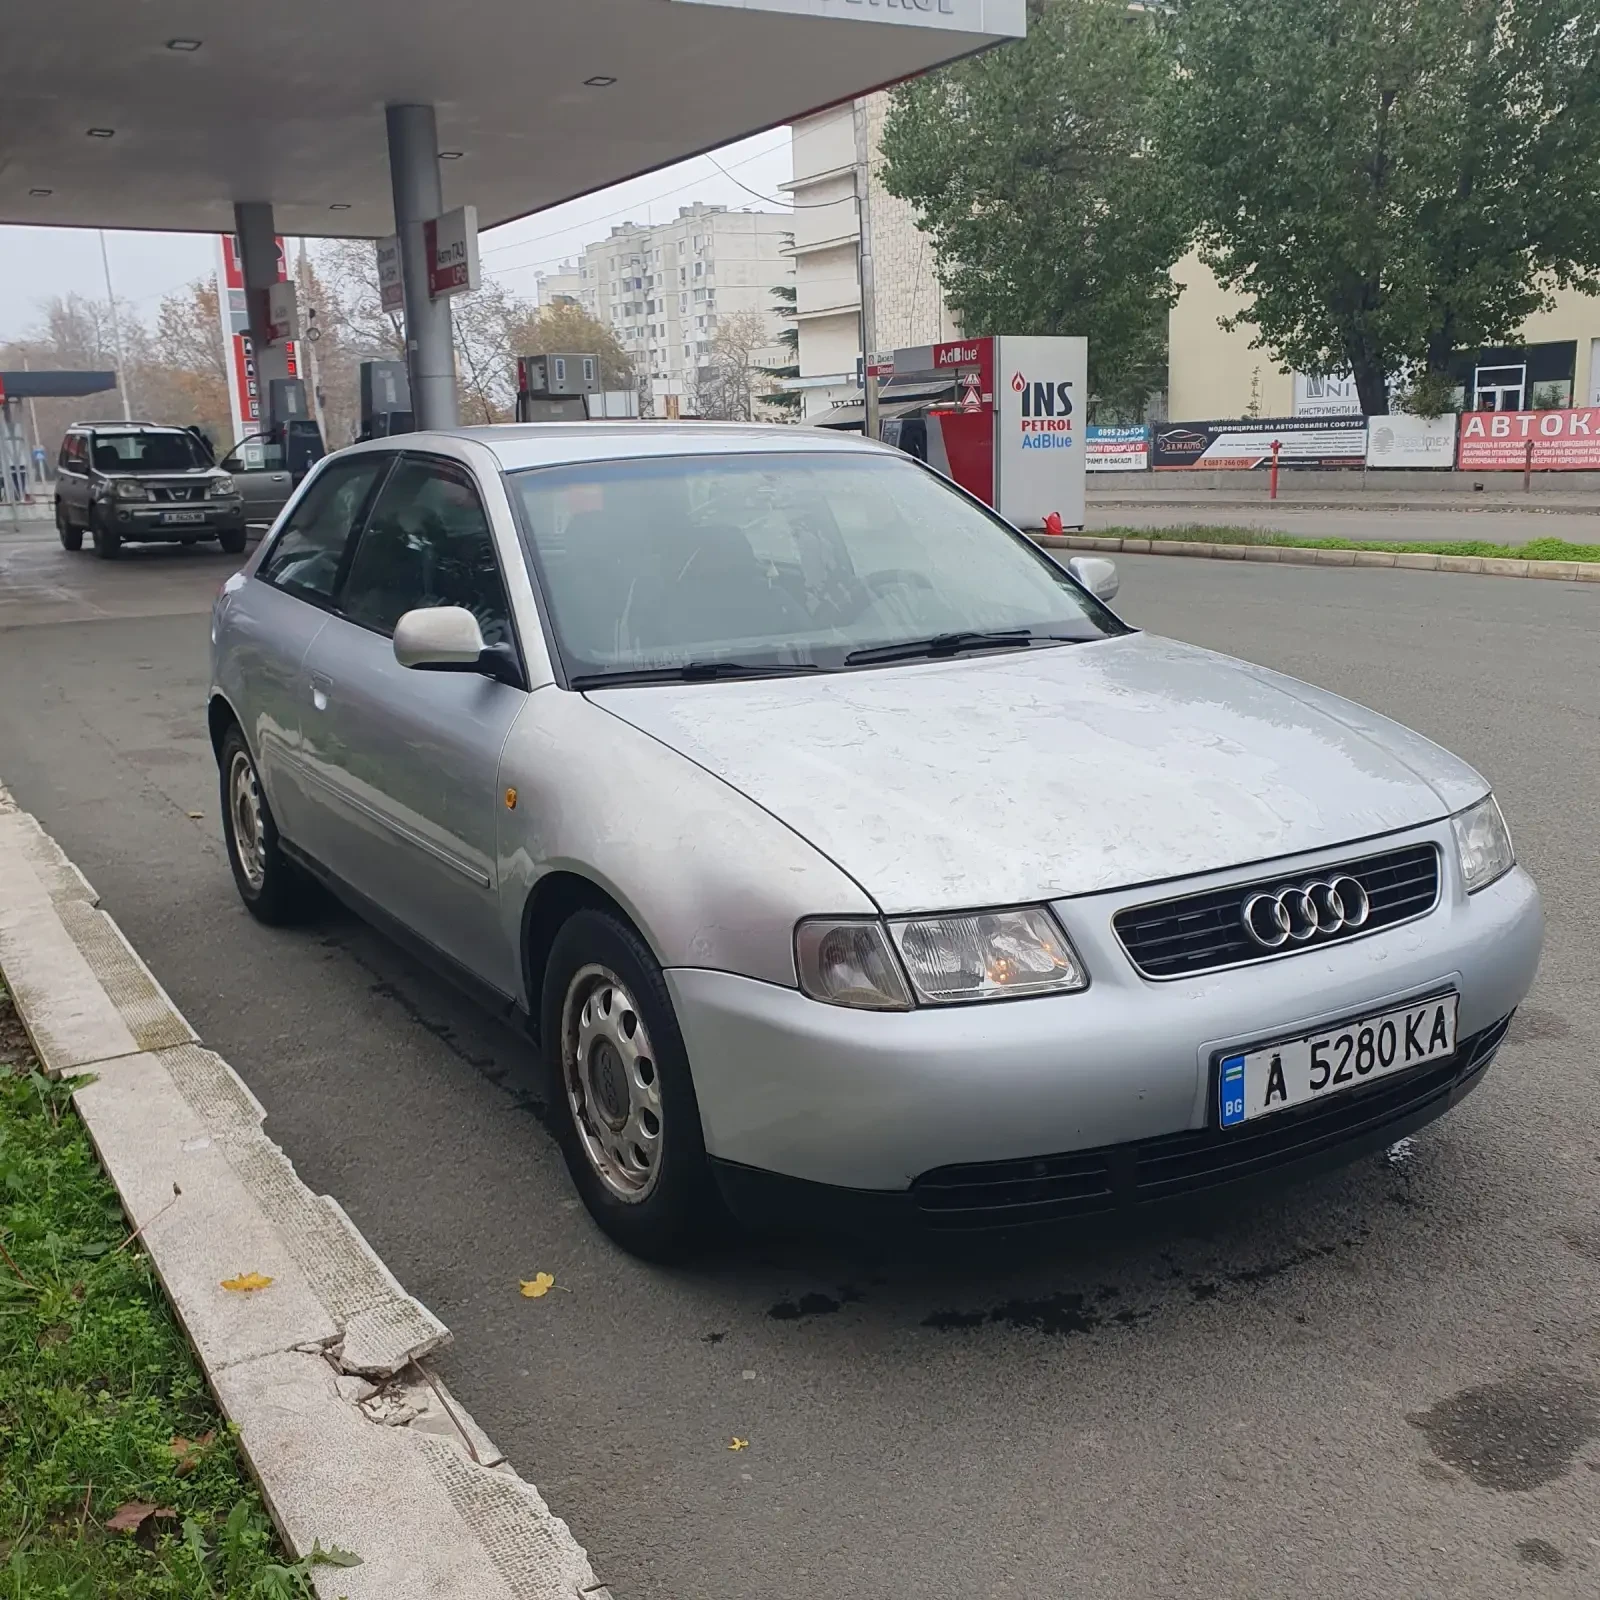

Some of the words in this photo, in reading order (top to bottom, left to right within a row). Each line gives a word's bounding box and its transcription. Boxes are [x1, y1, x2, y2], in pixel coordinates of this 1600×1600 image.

[877, 354, 893, 364] Дизел
[939, 347, 977, 364] AdBlue
[877, 364, 893, 374] Diesel
[1021, 382, 1073, 417] INS
[1299, 405, 1350, 415] ИНСТРУМЕНТИ
[1021, 419, 1073, 432] PETROL
[1208, 424, 1263, 432] МОДИФИЦИРАНЕ
[1276, 422, 1328, 430] АВТОМОБИЛЕН
[1022, 434, 1072, 449] AdBlue
[1183, 442, 1201, 450] AUTO
[1264, 1055, 1288, 1106] A
[1309, 1020, 1397, 1090] 5280
[1404, 1005, 1448, 1061] KA
[1225, 1098, 1243, 1117] BG
